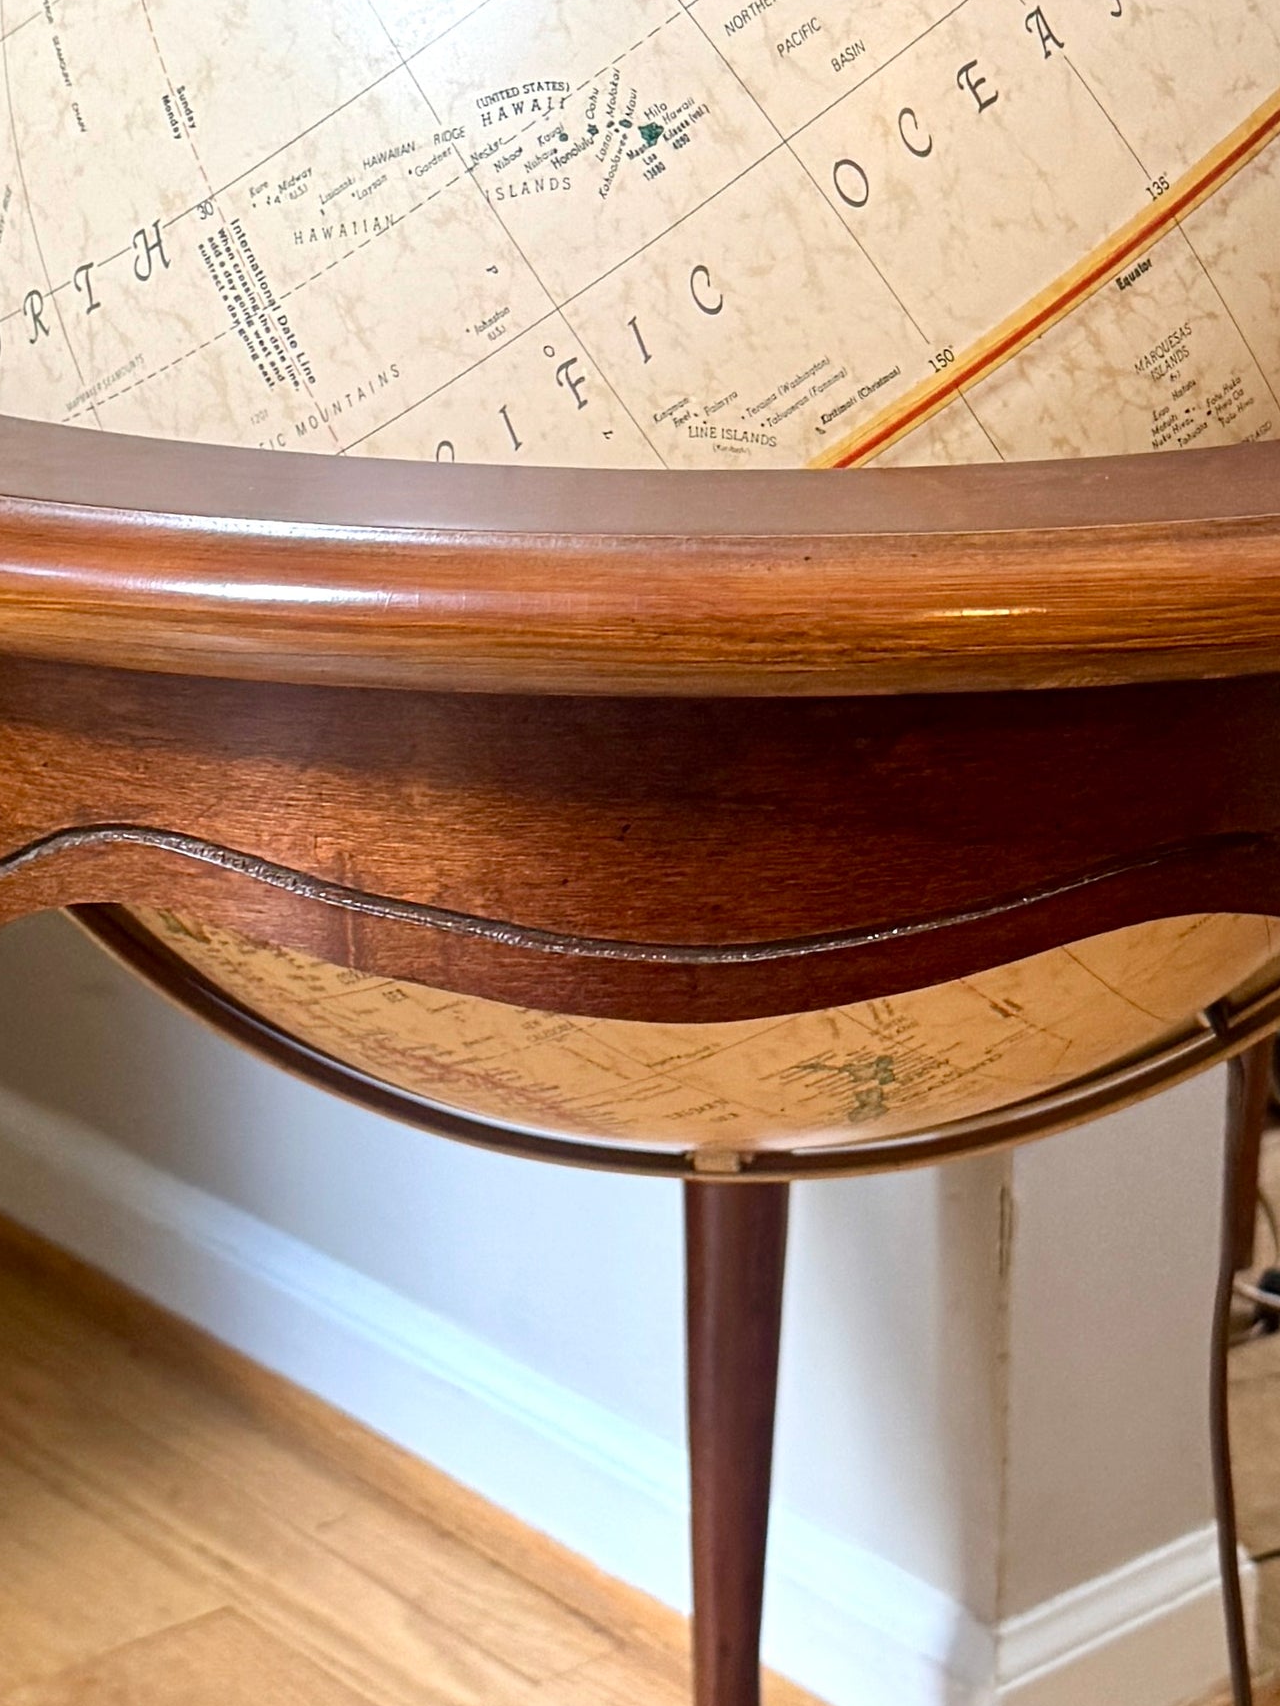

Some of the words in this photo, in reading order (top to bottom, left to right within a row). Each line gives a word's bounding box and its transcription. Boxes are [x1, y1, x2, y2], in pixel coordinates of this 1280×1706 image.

[776, 15, 822, 59] PACIFIC
[831, 39, 867, 73] BASIN
[161, 94, 182, 141] Monday
[176, 85, 197, 130] Sunday
[476, 85, 520, 110] (UNITED
[522, 81, 570, 96] STATES)
[481, 97, 567, 128] HAWAII
[643, 101, 668, 121] Hilo
[362, 141, 416, 170] HAWAIIAN
[550, 135, 595, 170] Honolulu
[293, 214, 396, 245] HAWAIIAN
[484, 176, 572, 203] ISLANDS
[218, 227, 235, 261] When
[233, 263, 260, 315] crossing
[258, 313, 271, 334] the
[270, 336, 287, 363] date
[1115, 258, 1154, 292] Equator
[198, 243, 225, 292] subtract
[227, 303, 241, 327] day
[237, 328, 259, 362] going
[207, 236, 223, 258] add
[223, 270, 237, 292] day
[233, 294, 255, 328] going
[253, 329, 272, 358] west
[269, 360, 285, 382] and
[230, 218, 281, 311] International
[277, 314, 298, 349] Date
[296, 351, 316, 385] Line
[1134, 322, 1193, 375] MARQUESAS
[1150, 345, 1190, 382] ISLANDS
[294, 363, 401, 439] MOUNTAINS
[688, 426, 717, 439] LINE
[721, 428, 778, 448] ISLANDS
